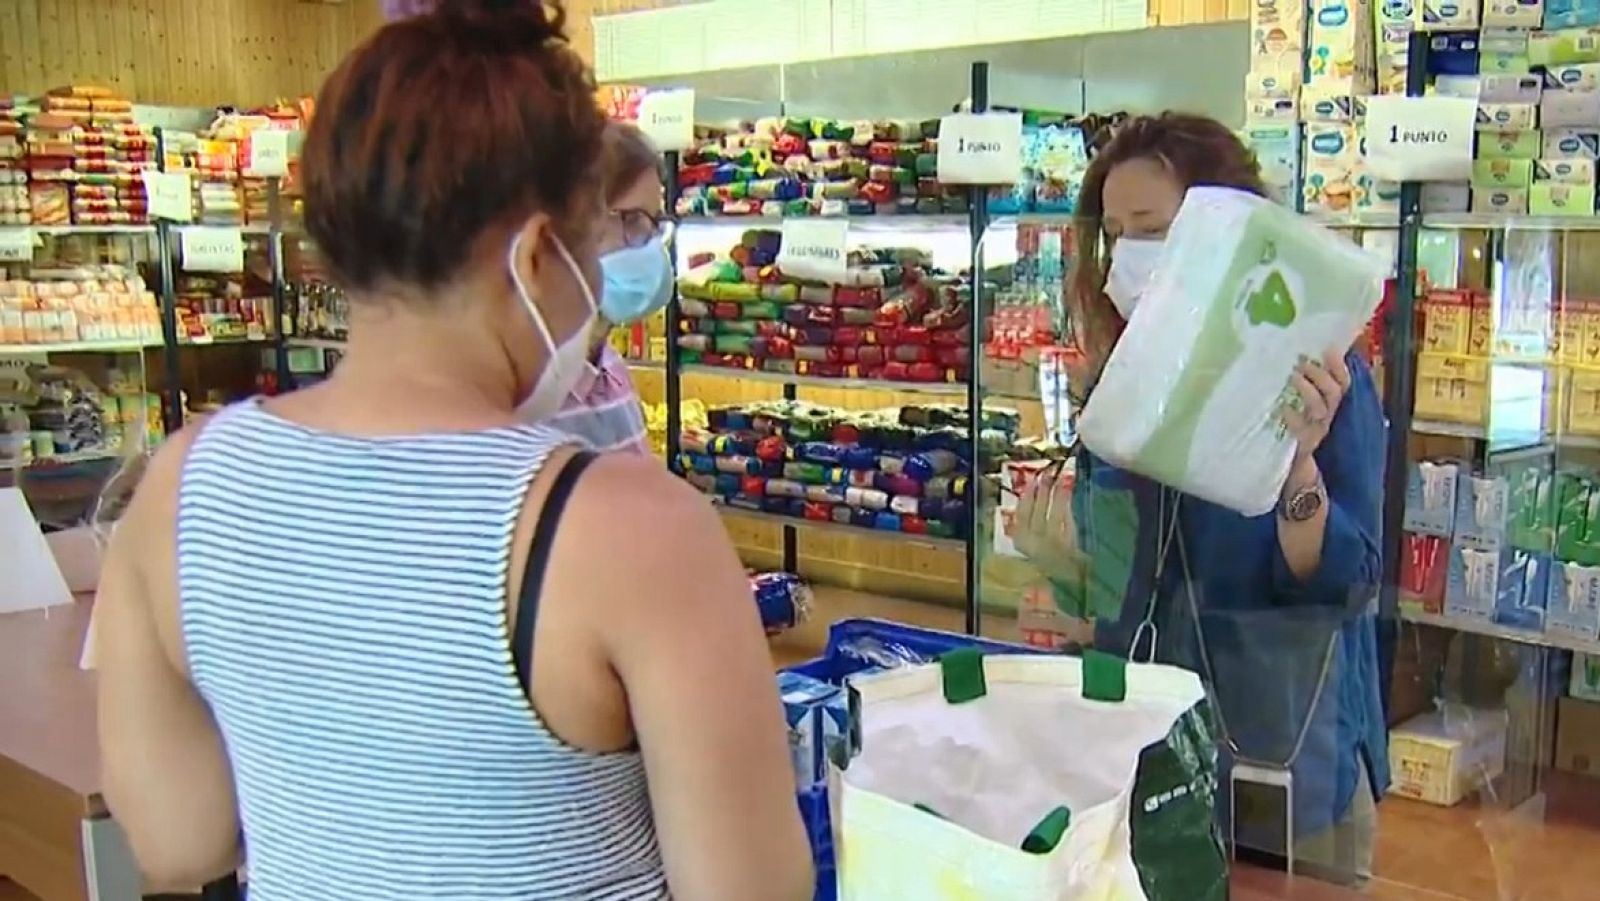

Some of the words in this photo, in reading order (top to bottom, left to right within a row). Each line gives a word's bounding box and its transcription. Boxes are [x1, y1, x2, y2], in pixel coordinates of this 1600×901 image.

[1389, 125, 1398, 143] 1
[1402, 131, 1448, 143] PUNTO
[957, 137, 964, 153] 1
[966, 142, 1001, 153] PUNTO
